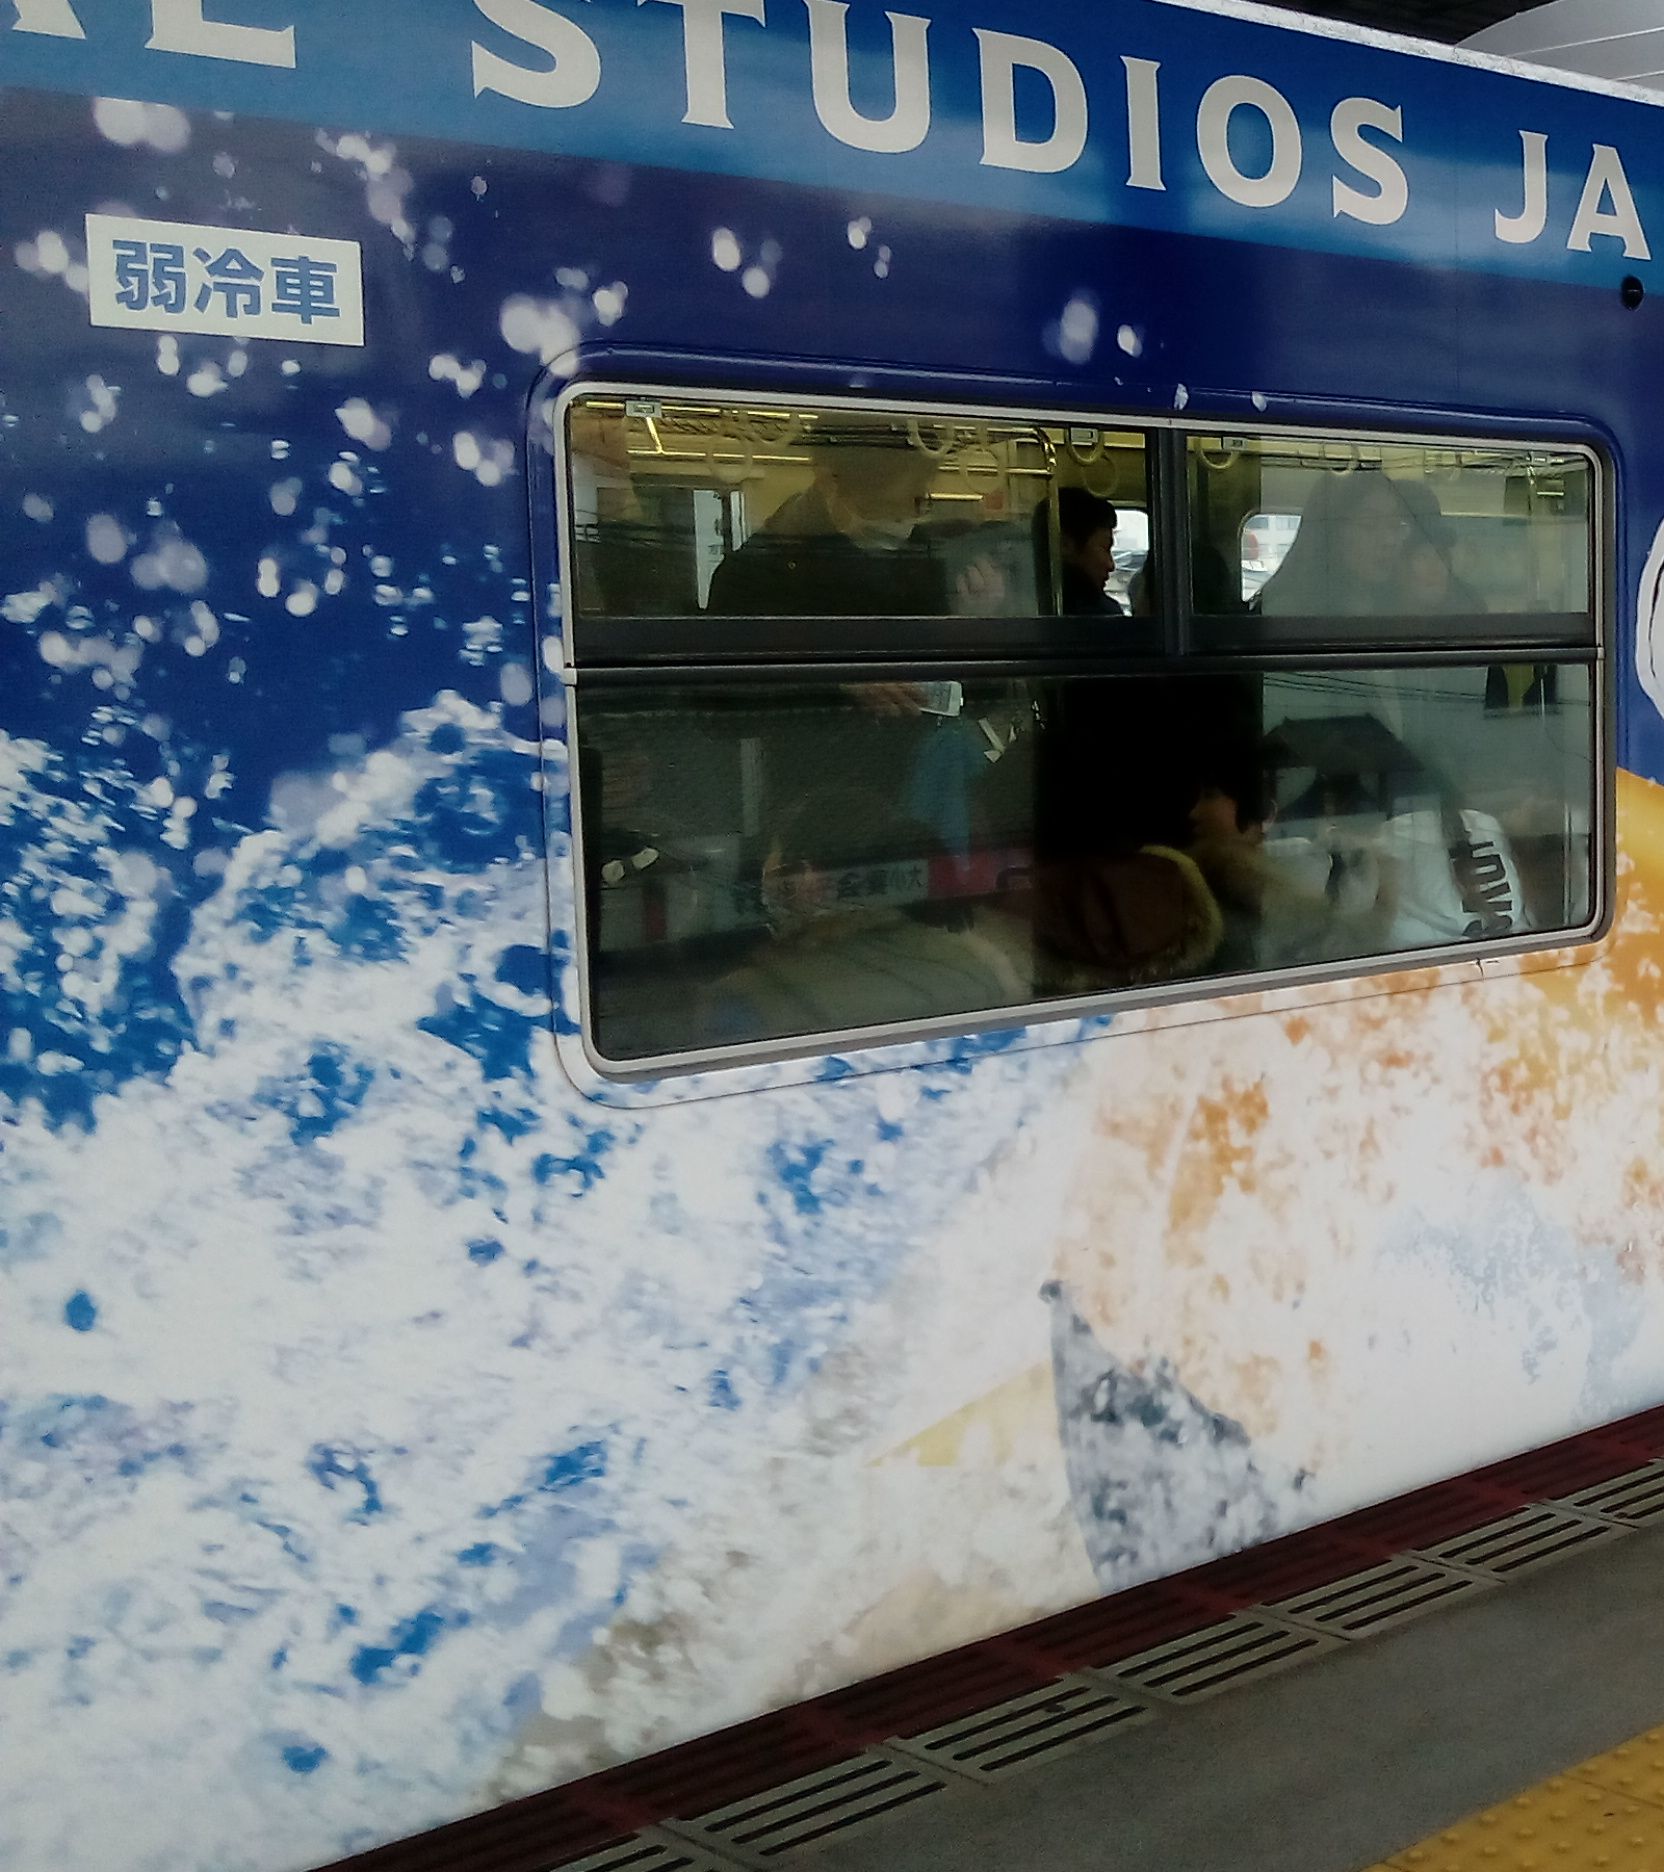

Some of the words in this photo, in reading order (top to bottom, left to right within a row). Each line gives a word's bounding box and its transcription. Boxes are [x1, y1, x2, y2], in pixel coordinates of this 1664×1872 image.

[470, 0, 1410, 227] STUDIOS
[110, 239, 342, 325] 弱冷車
